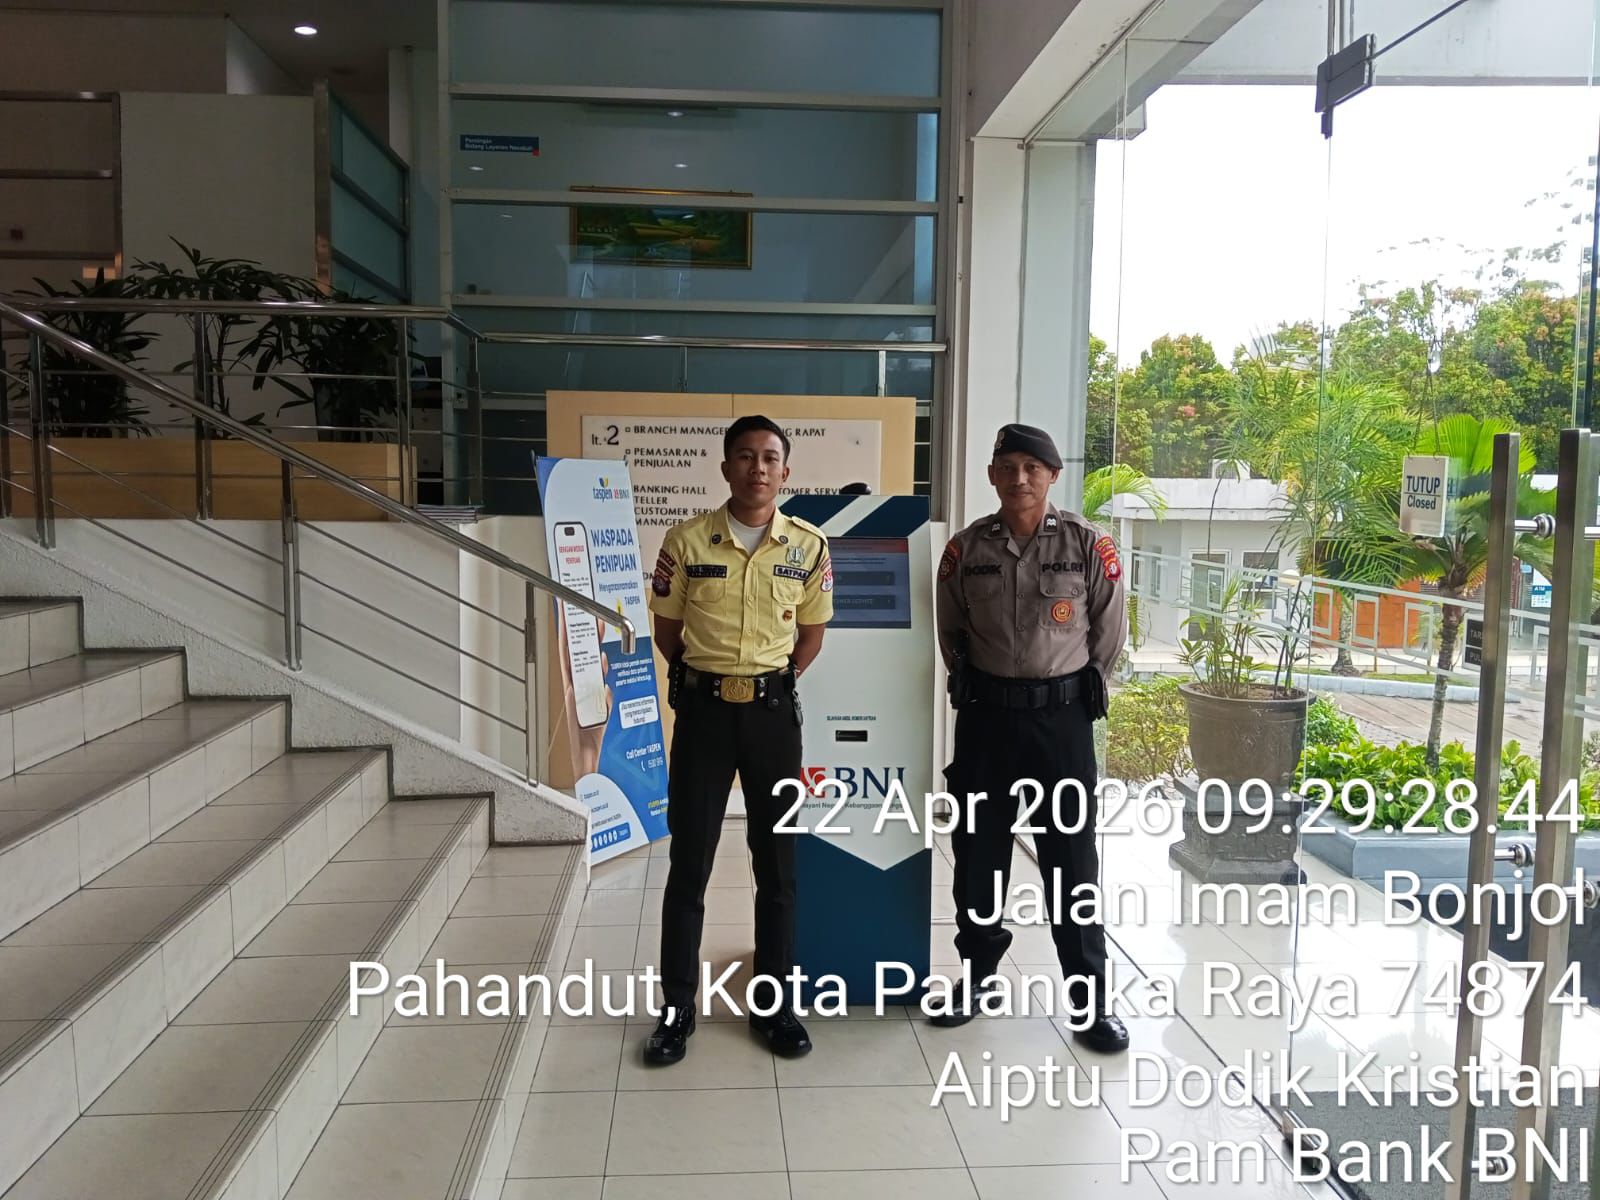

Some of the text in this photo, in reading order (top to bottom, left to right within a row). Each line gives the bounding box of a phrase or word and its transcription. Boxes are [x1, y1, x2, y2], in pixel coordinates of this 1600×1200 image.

[606, 425, 619, 445] 2
[634, 425, 677, 434] BRANCH
[795, 428, 825, 437] RAPAT
[634, 448, 707, 457] PEMASARAN &
[634, 458, 691, 467] PENJUALAN
[634, 485, 707, 495] BANKING HALL
[1406, 475, 1441, 494] TUTUP
[593, 486, 612, 503] taspen
[634, 496, 668, 504] TELLER
[1407, 495, 1436, 510] Closed
[634, 506, 688, 516] CUSTOMER
[591, 528, 633, 547] WASPADA
[595, 554, 637, 573] PENIPUAN
[1042, 561, 1083, 573] POLRI
[834, 767, 906, 799] BNI
